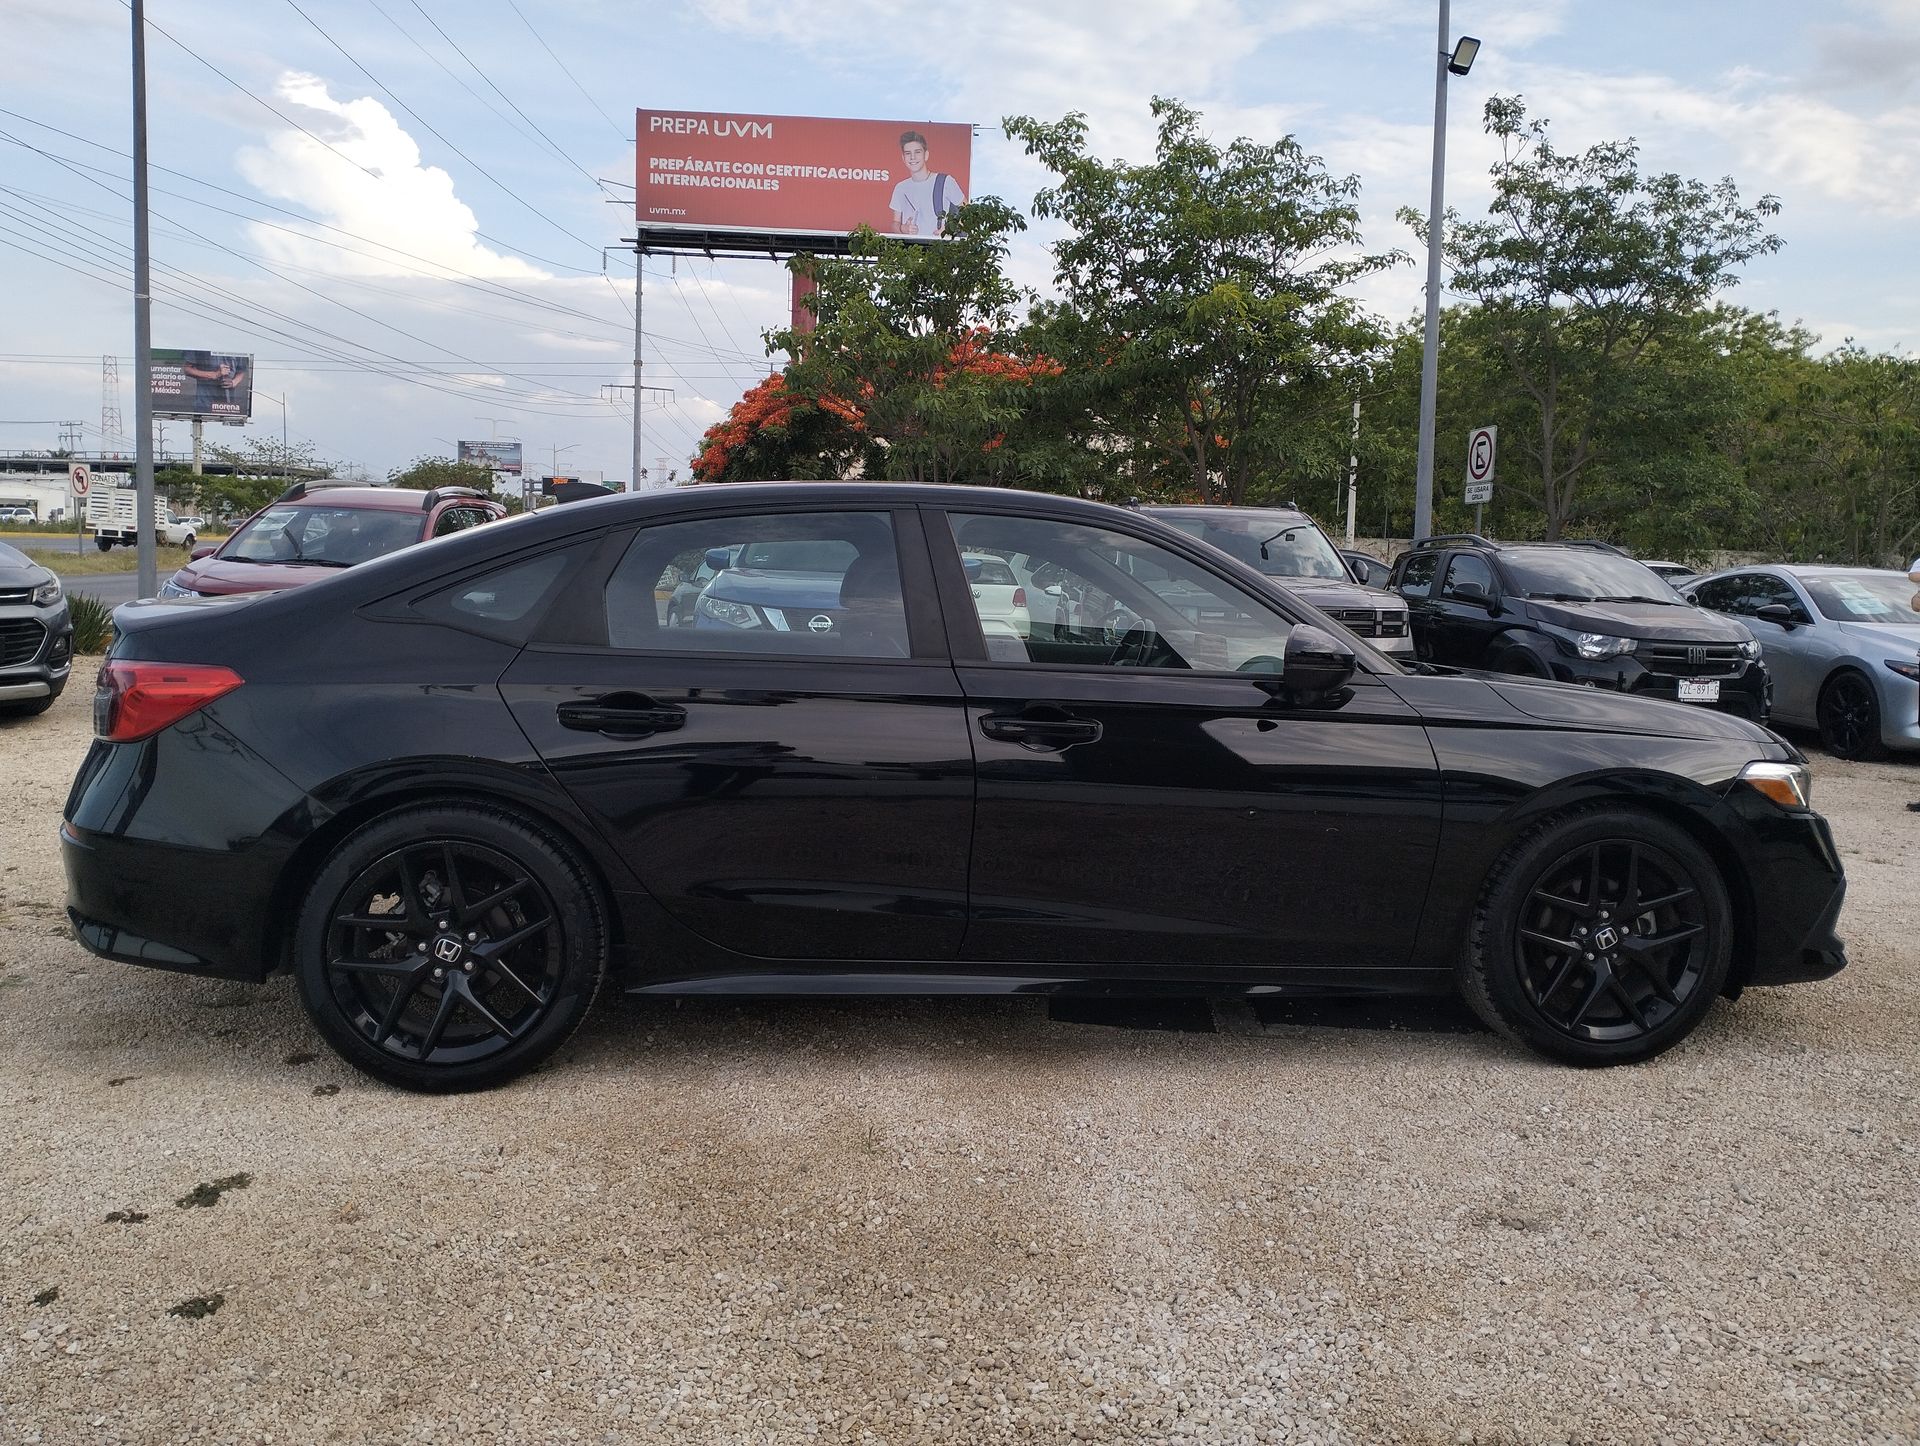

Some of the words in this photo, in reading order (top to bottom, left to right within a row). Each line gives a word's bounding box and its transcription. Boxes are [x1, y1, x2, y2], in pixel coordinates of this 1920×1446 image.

[650, 116, 709, 135] PREPA
[714, 119, 773, 139] UVM
[650, 156, 730, 173] PREPÁRATE
[732, 162, 764, 175] CON
[765, 164, 890, 181] CERTIFICACIONES
[649, 173, 780, 191] INTERNACIONALES
[649, 207, 686, 216] uvm.mx
[150, 365, 182, 373] umentar
[152, 372, 177, 380] salario
[165, 379, 181, 387] bien
[211, 403, 240, 411] morena
[1688, 647, 1708, 664] FIAT
